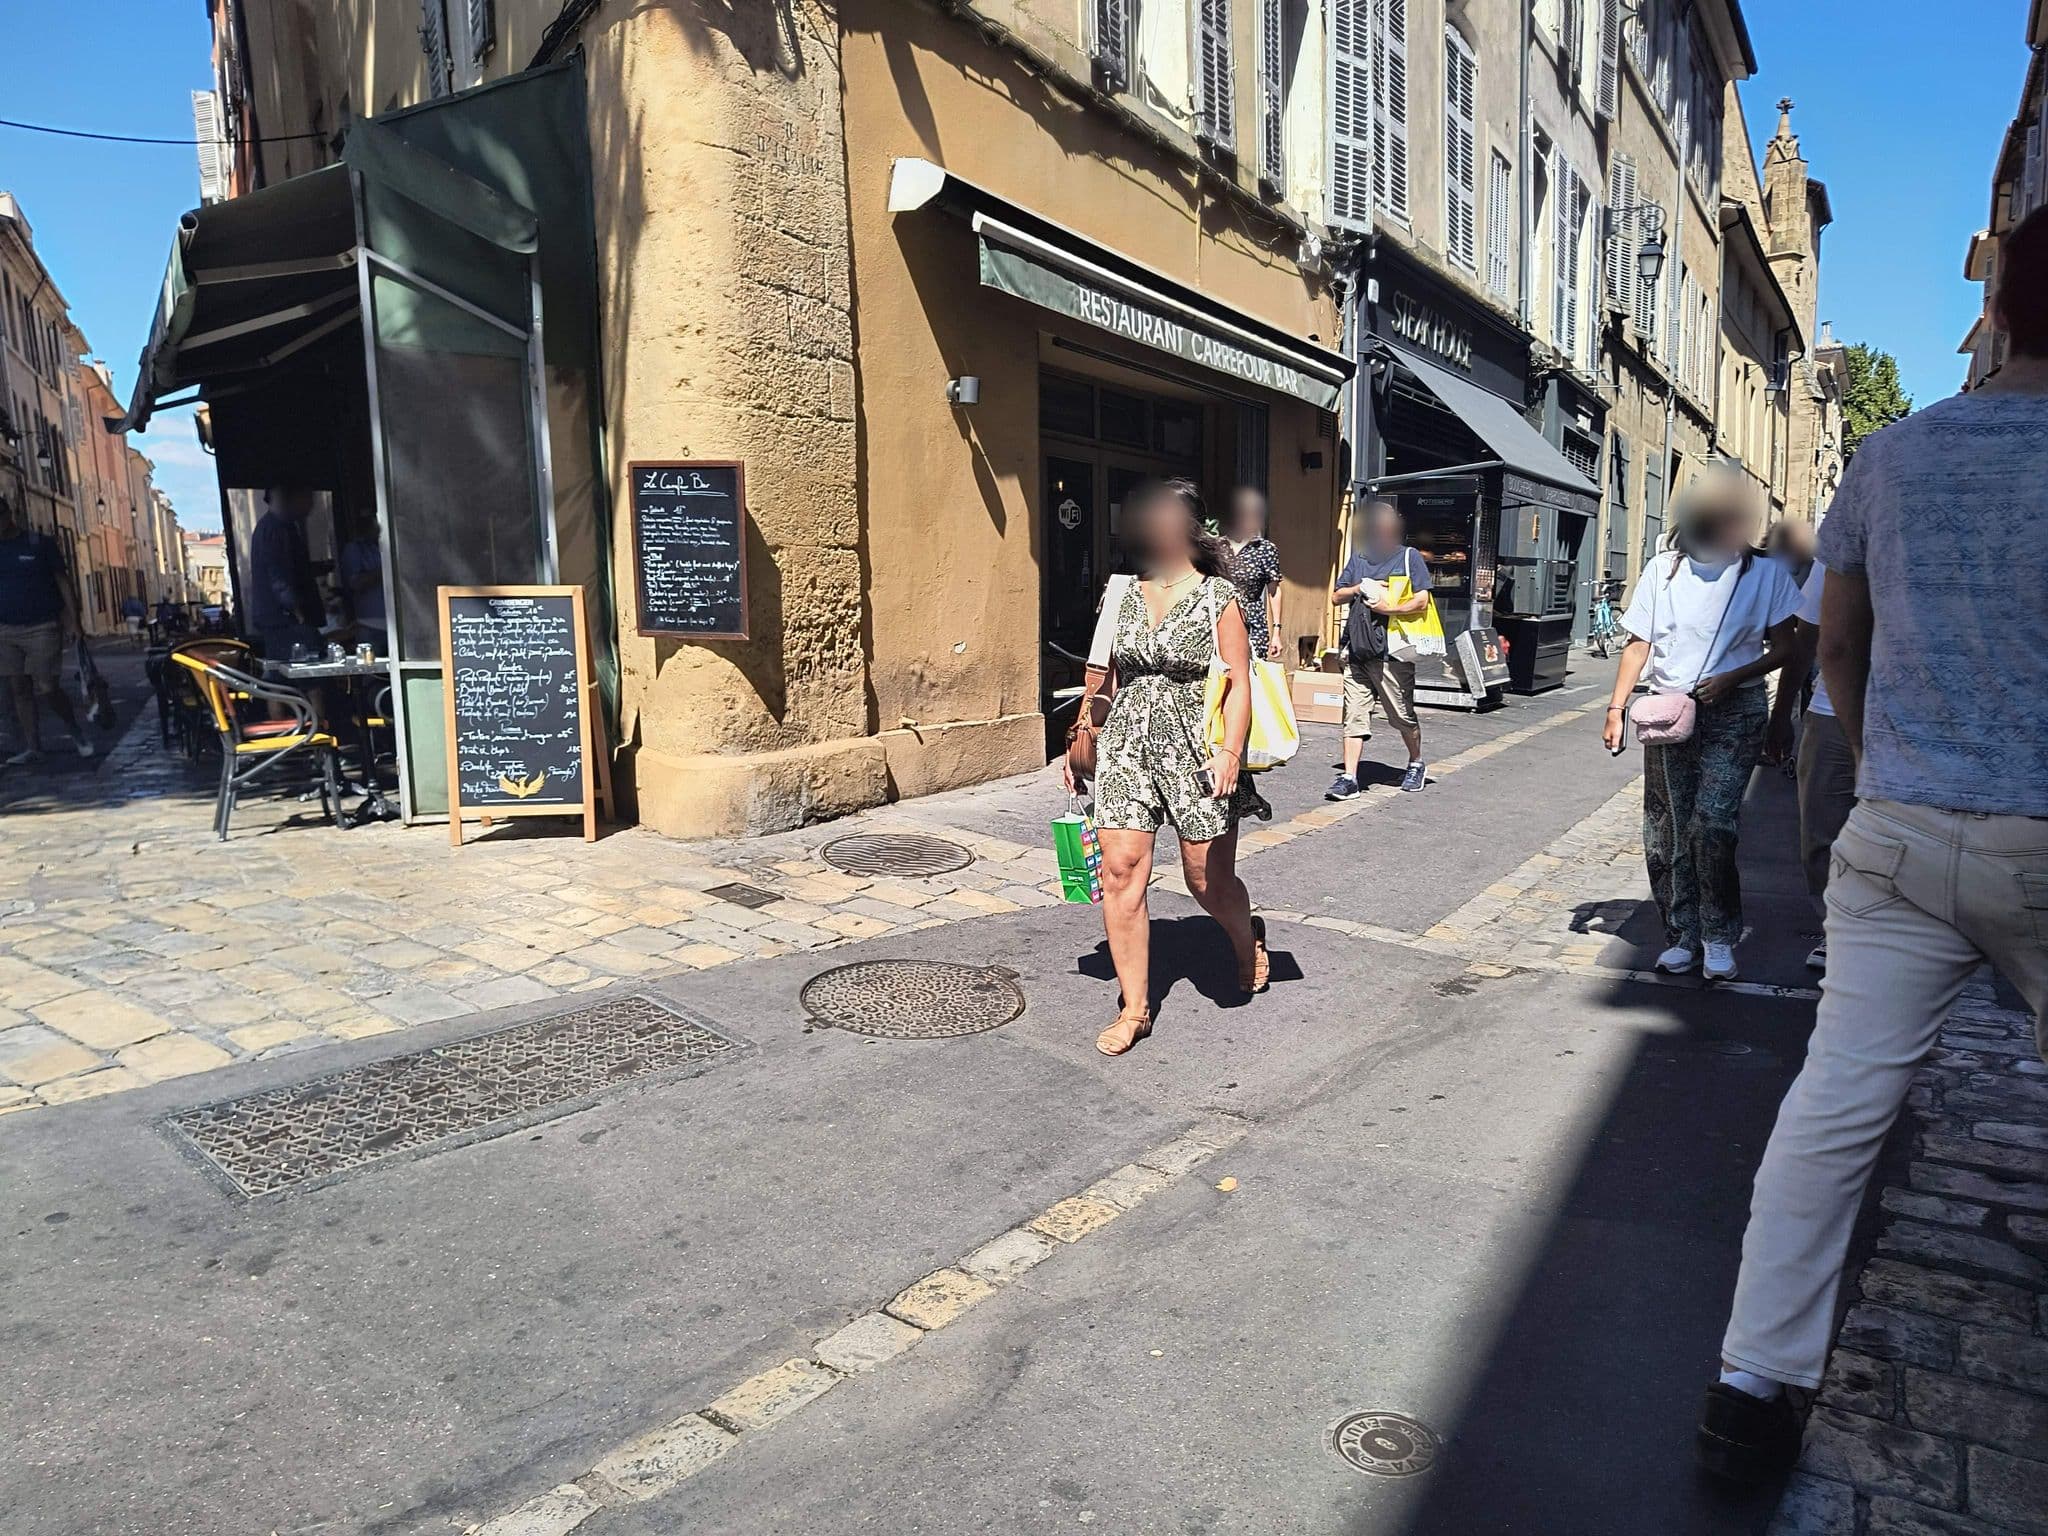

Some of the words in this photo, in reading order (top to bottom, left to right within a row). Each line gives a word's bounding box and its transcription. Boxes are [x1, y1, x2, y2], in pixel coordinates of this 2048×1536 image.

[1078, 287, 1184, 354] RESTAURANT
[1191, 332, 1271, 385] CARREFOUR
[1274, 363, 1299, 394] BAR
[1342, 1418, 1381, 1446] EAUX
